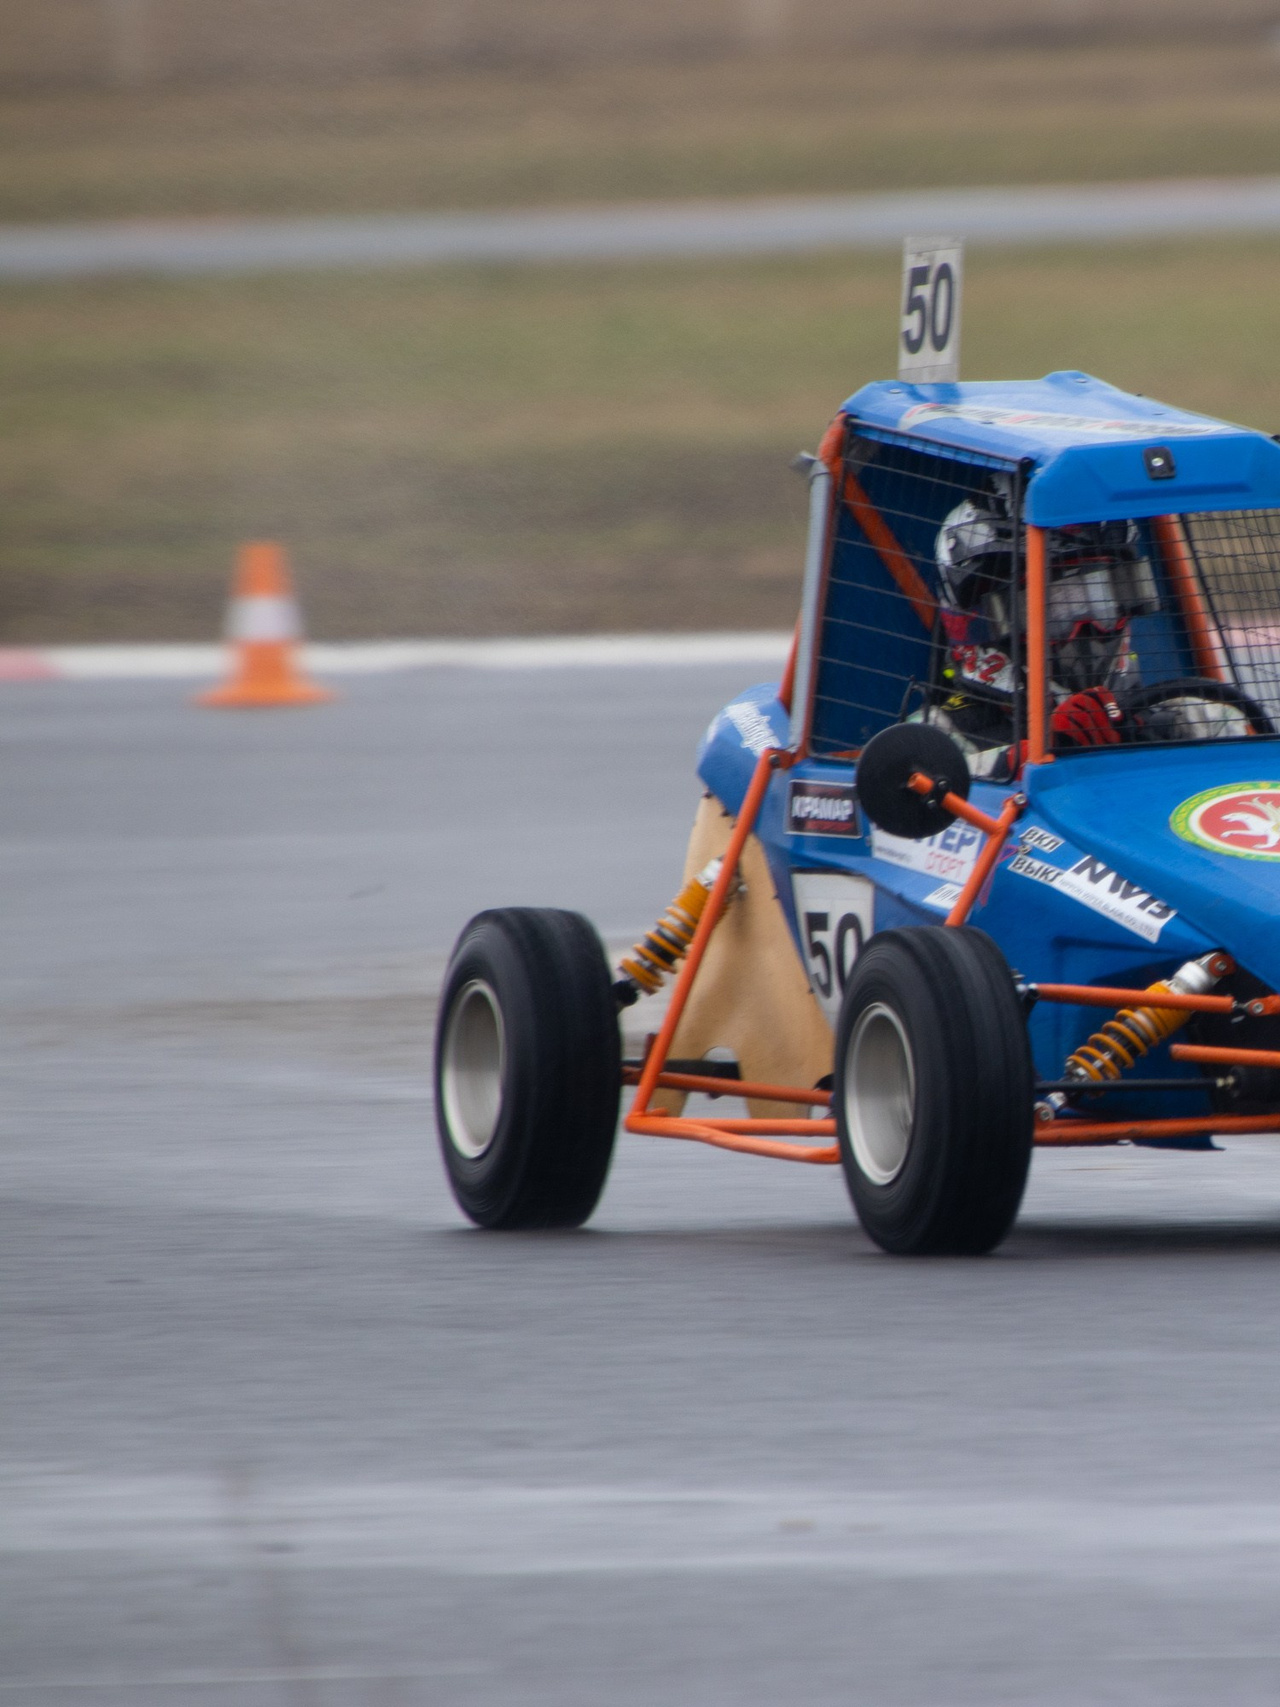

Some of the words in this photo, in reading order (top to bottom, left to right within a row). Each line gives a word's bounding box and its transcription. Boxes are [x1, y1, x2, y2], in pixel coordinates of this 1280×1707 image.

[902, 262, 953, 354] 50
[1022, 828, 1061, 851] ВКЛ
[1072, 855, 1174, 920] NWB
[805, 911, 864, 1000] 50
